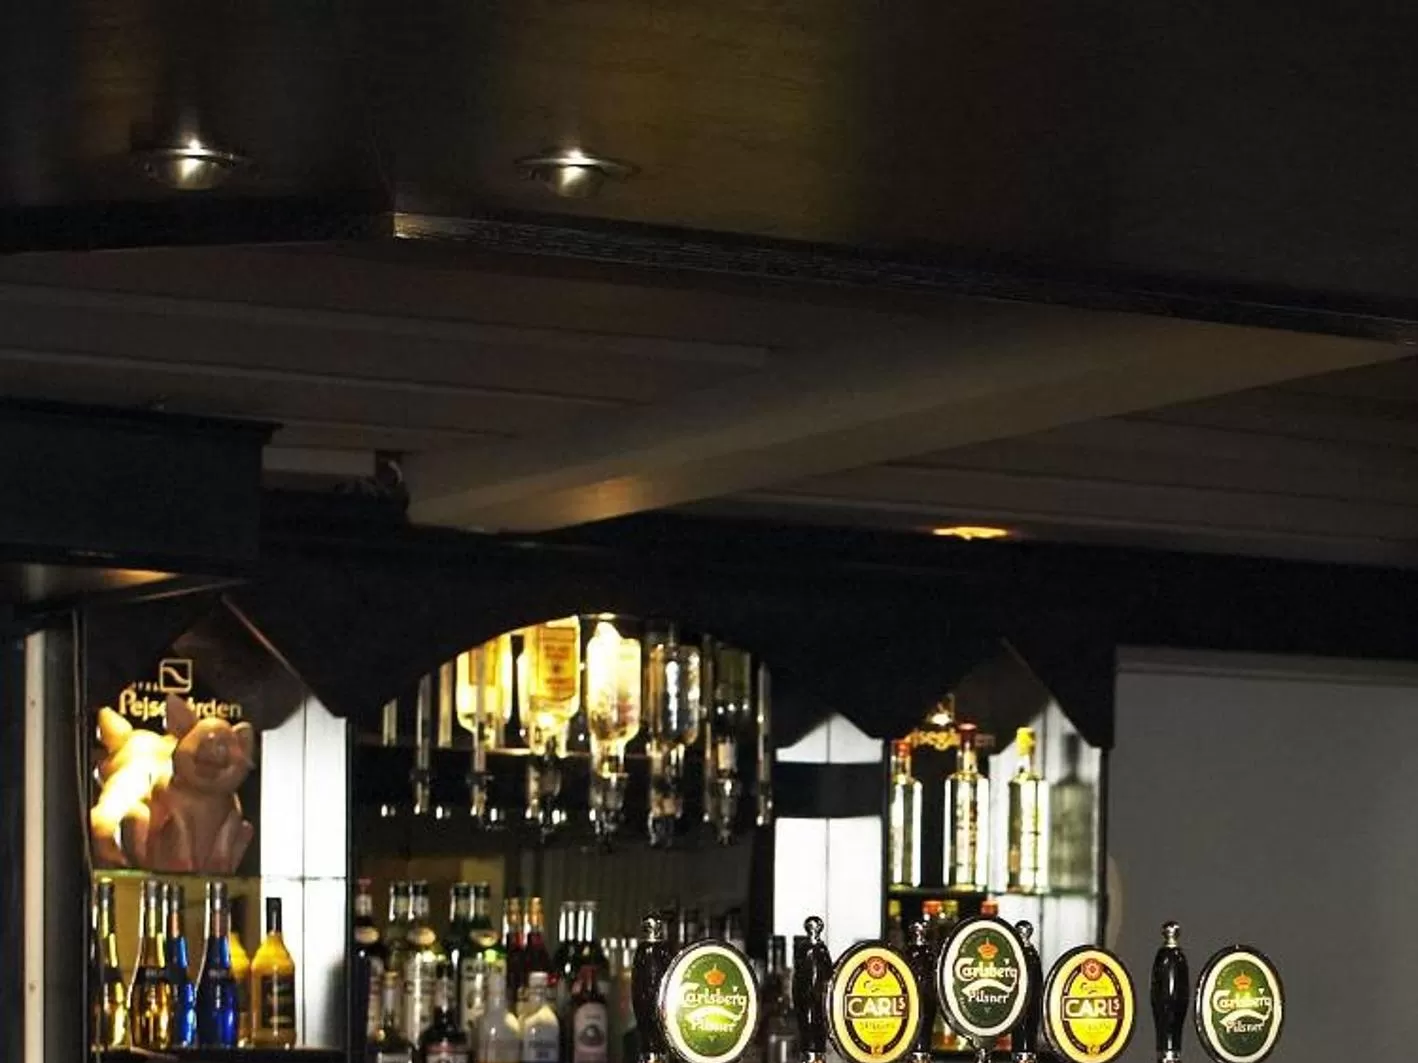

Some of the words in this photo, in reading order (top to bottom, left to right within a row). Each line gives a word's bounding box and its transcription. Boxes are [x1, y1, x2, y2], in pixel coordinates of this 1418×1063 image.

[119, 688, 242, 722] Pejsrden
[954, 957, 1018, 985] Carlsberg
[679, 982, 748, 1013] Carlsberg
[967, 989, 1010, 1004] Pilsner
